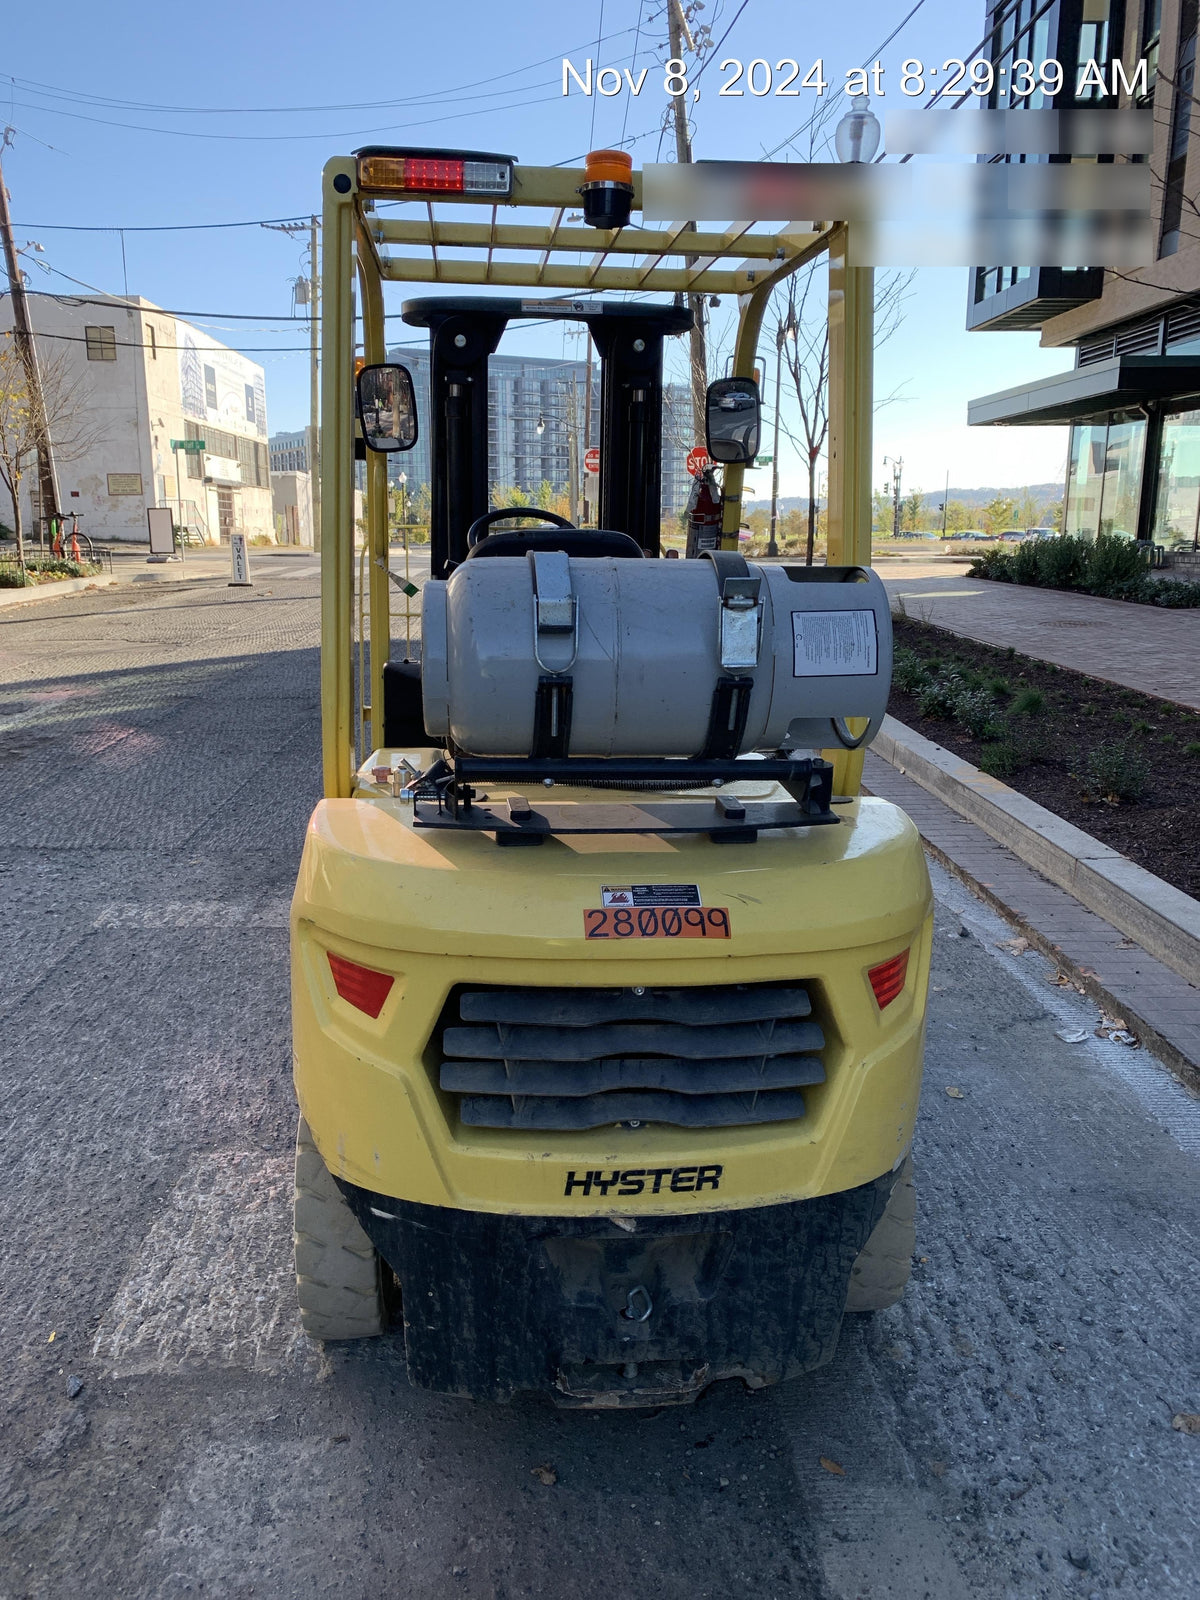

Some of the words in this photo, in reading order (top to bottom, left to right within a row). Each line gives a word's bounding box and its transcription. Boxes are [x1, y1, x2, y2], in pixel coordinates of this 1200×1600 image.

[235, 547, 244, 580] VALET
[587, 908, 730, 938] 280099
[564, 1164, 724, 1197] HYSTER
